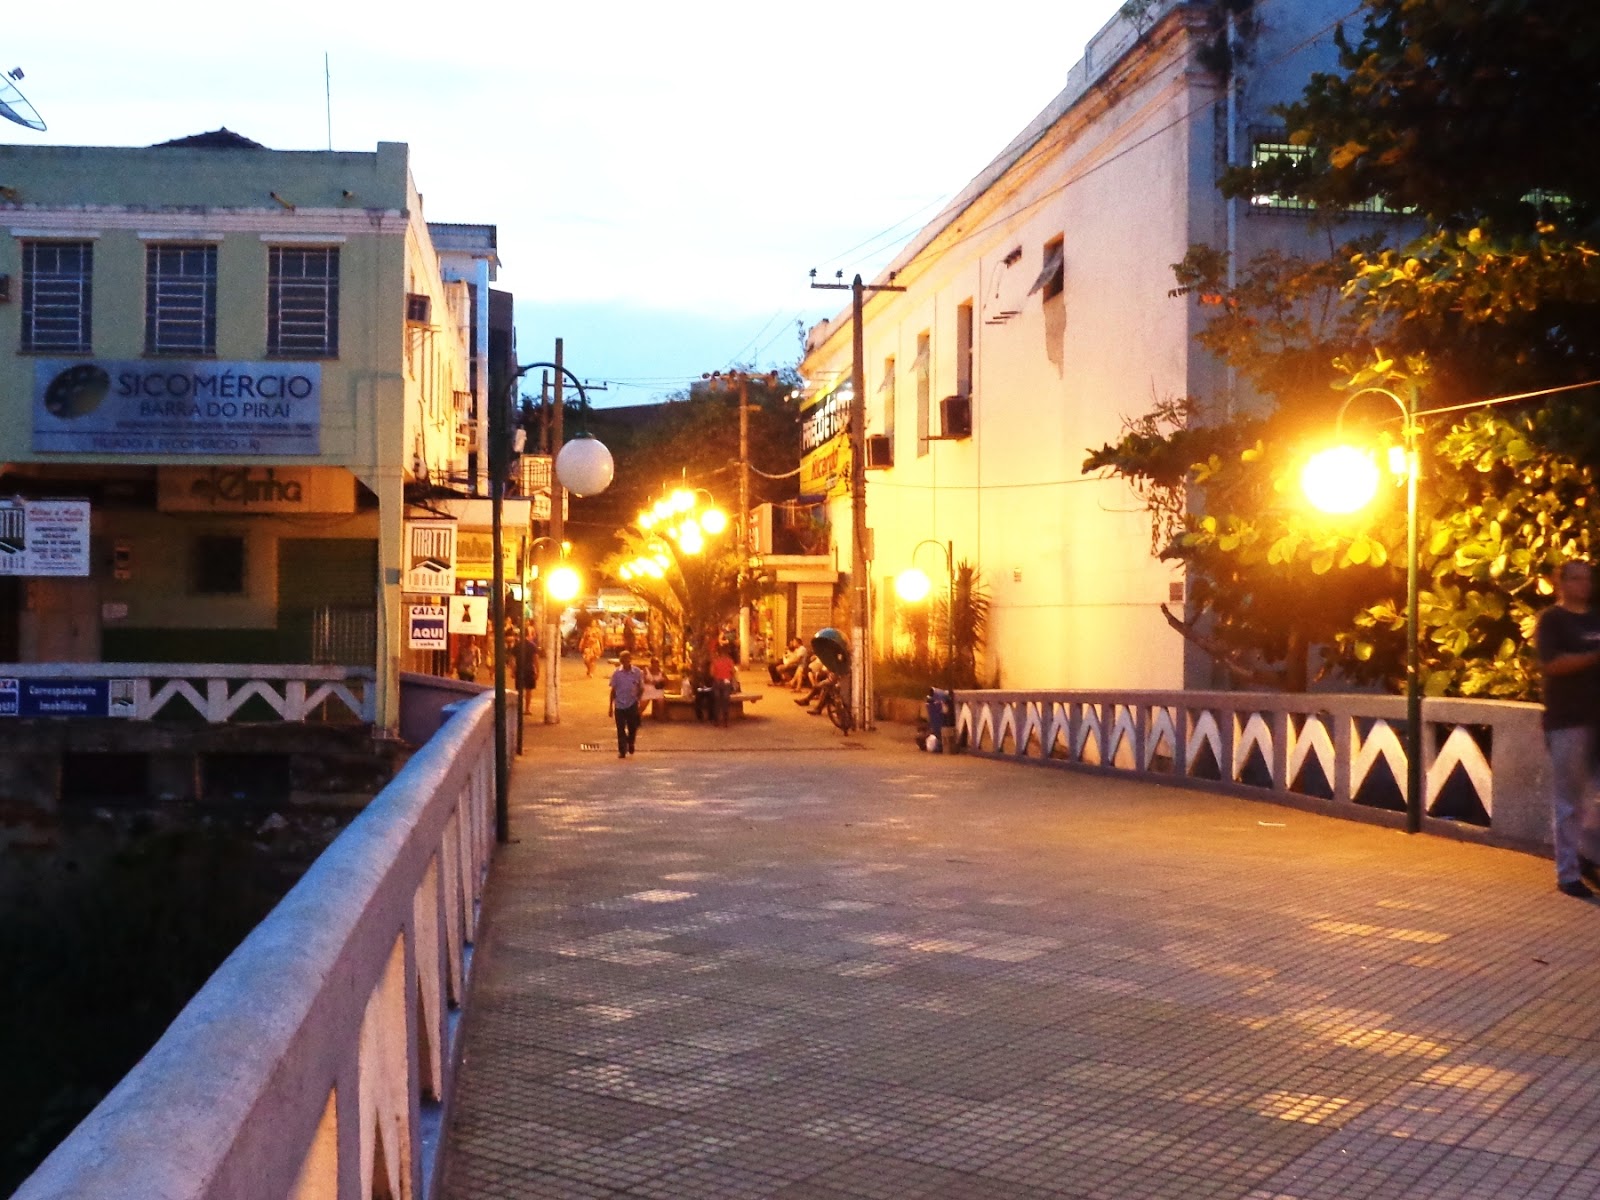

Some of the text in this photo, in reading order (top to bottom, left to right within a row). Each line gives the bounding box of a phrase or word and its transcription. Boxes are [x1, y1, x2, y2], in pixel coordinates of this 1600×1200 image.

[118, 369, 312, 399] SICOMÉRCIO
[140, 401, 200, 416] BARRA
[207, 402, 238, 418] DO
[412, 606, 444, 616] CAIXA
[413, 627, 444, 639] AQUI
